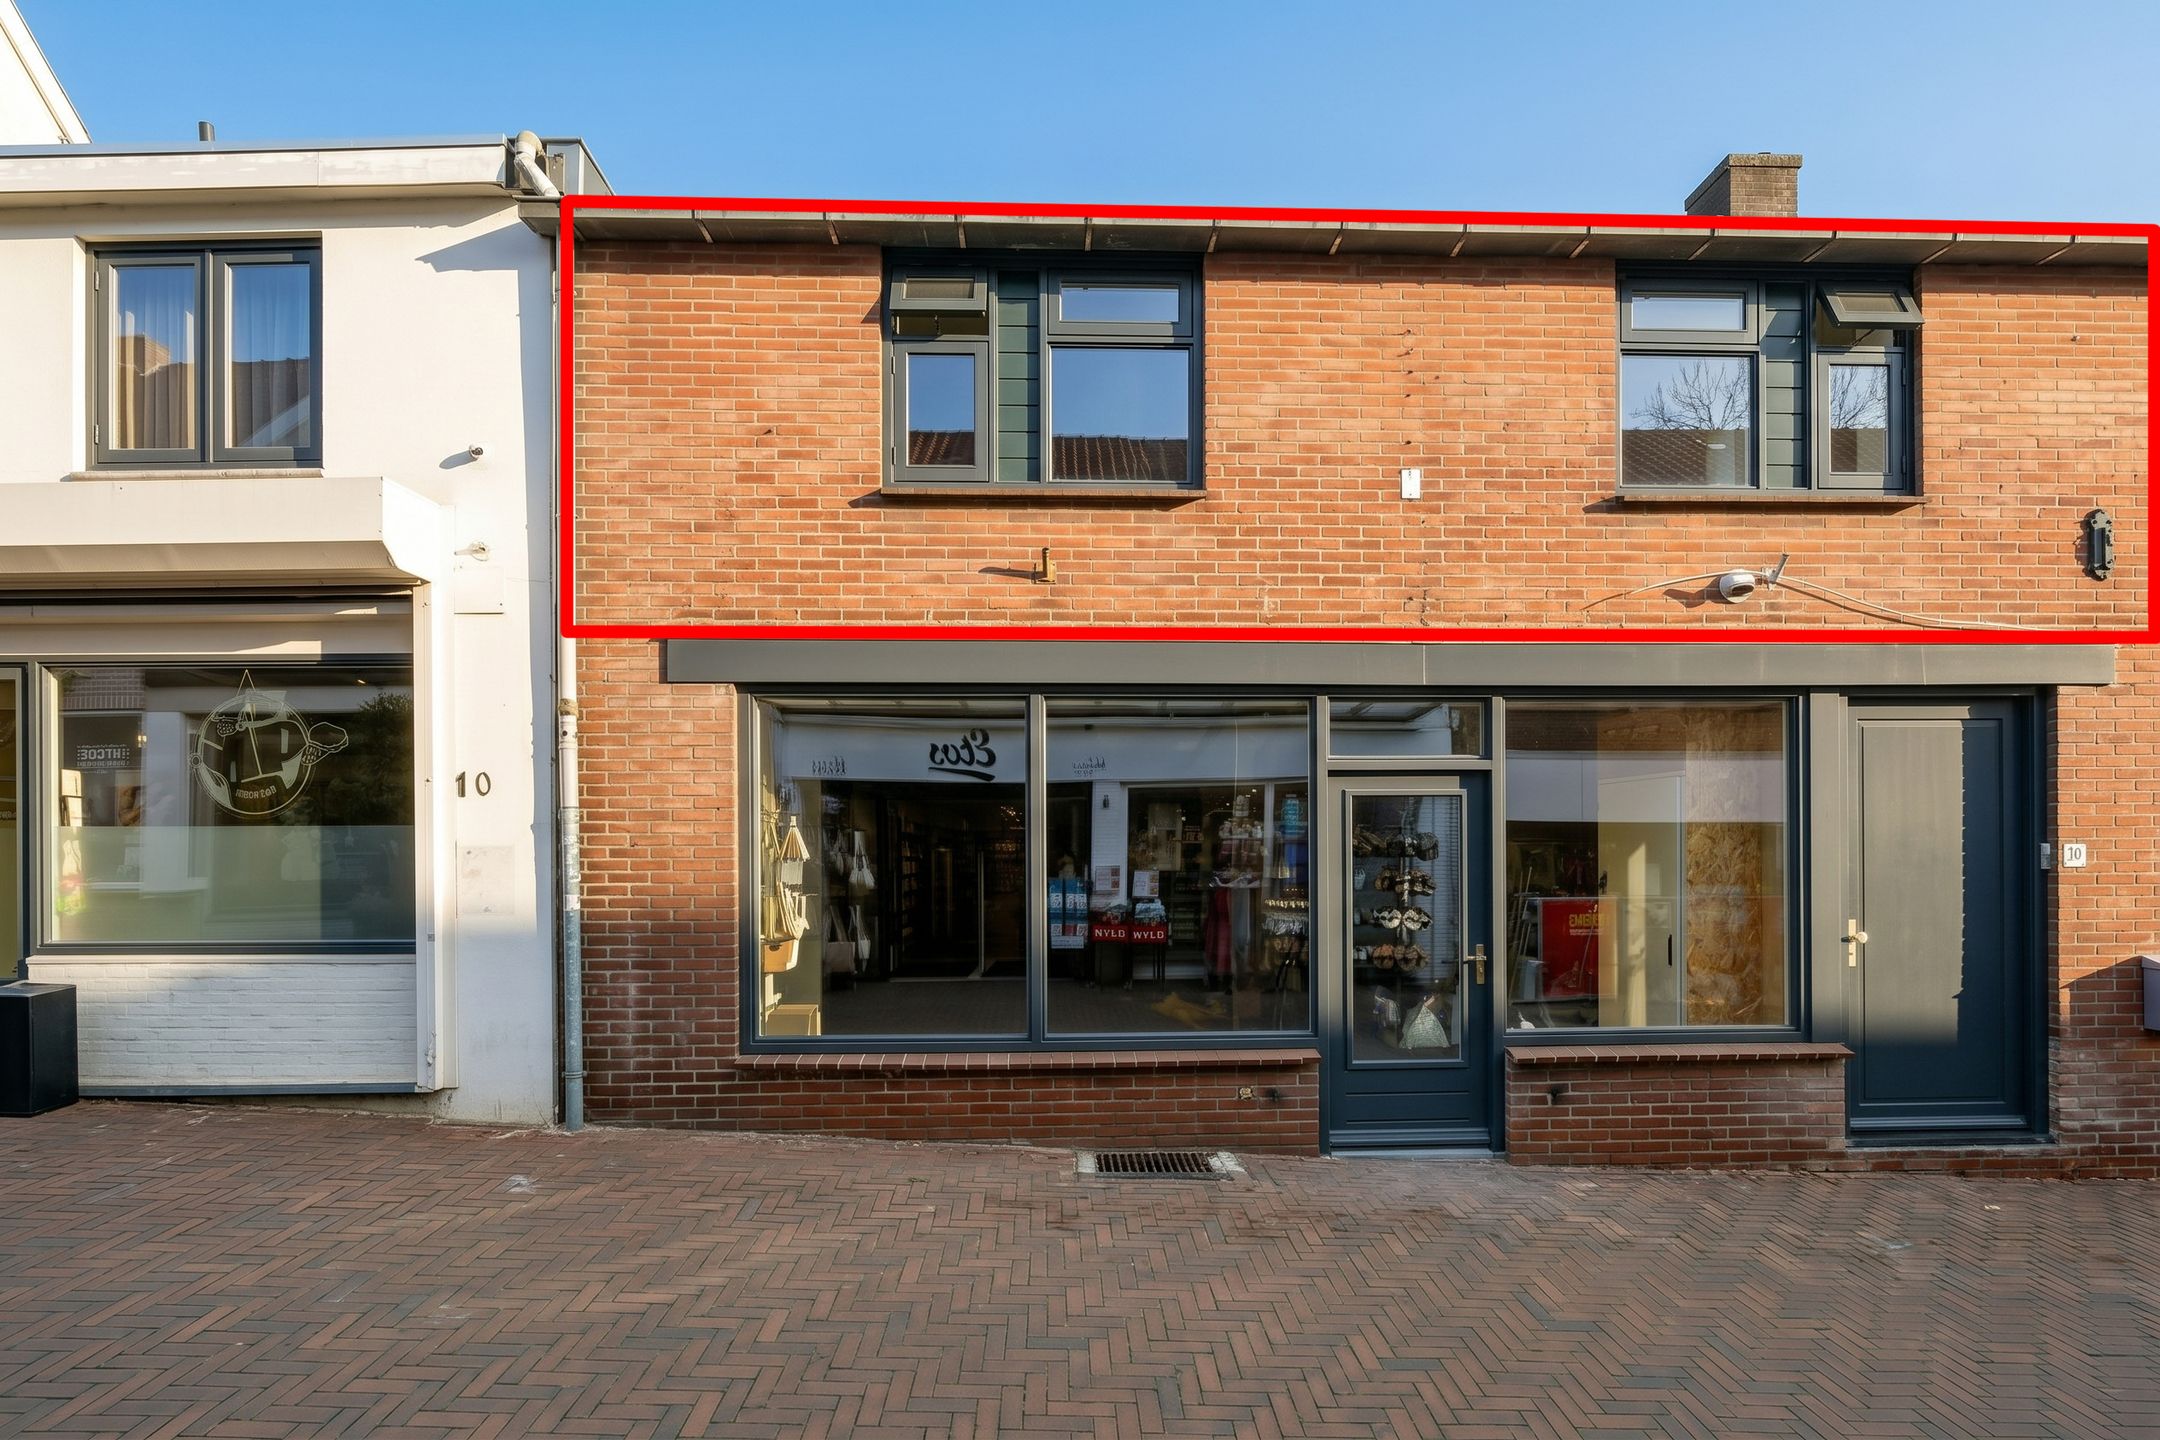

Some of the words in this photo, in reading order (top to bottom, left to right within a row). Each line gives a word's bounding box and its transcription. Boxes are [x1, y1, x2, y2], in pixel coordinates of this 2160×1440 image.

[455, 771, 491, 798] 10
[2066, 846, 2082, 861] 10
[1133, 930, 1165, 939] WYLD
